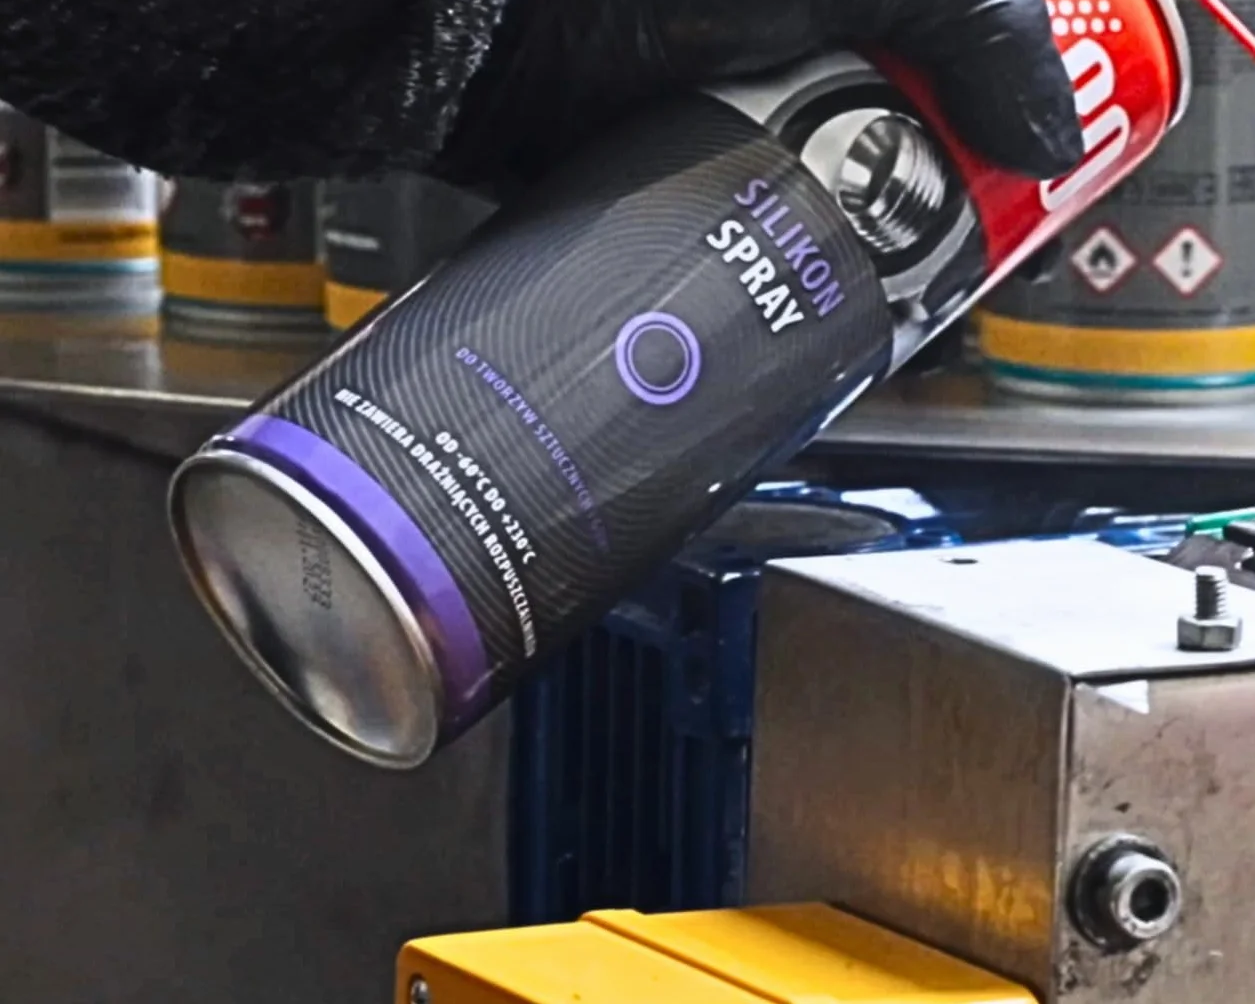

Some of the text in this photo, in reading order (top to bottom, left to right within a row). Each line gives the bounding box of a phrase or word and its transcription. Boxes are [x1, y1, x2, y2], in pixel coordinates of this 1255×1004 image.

[705, 219, 805, 333] SPRAY
[734, 178, 845, 317] SILIKON
[455, 347, 479, 366] DO
[475, 360, 539, 425] TWORZYW
[434, 431, 460, 454] OD
[456, 452, 492, 491] -60°C
[482, 487, 507, 512] DO
